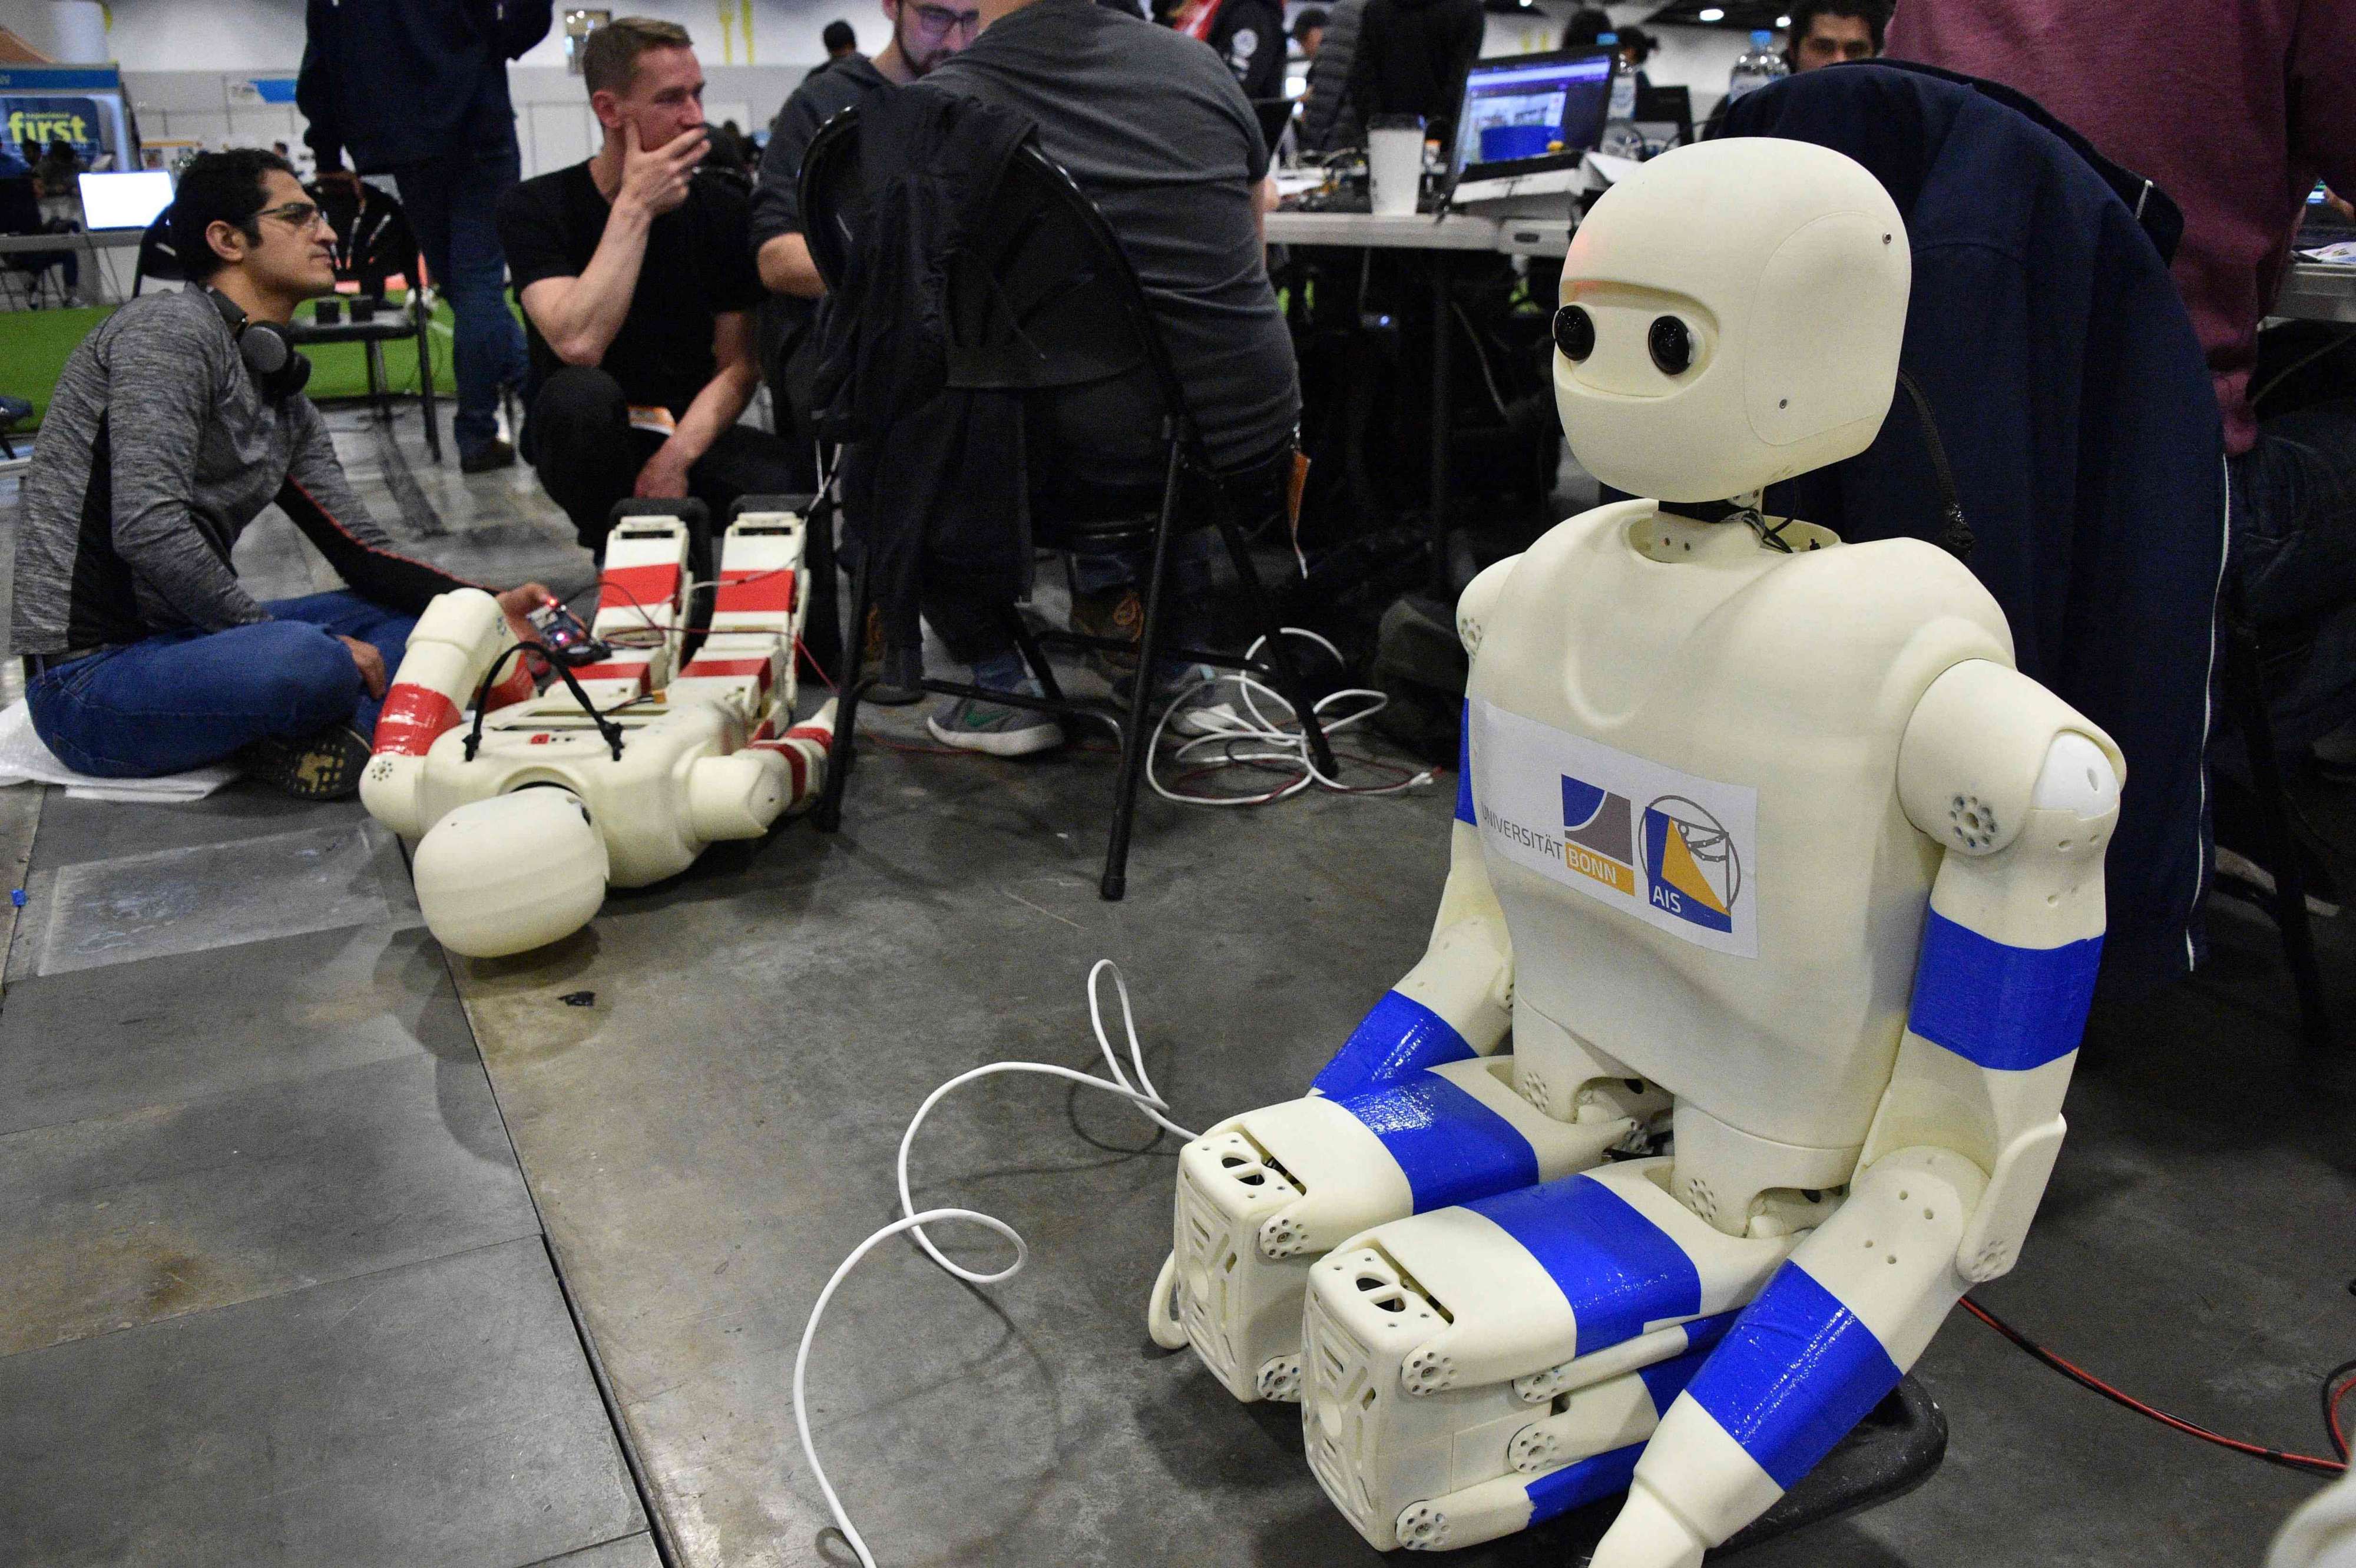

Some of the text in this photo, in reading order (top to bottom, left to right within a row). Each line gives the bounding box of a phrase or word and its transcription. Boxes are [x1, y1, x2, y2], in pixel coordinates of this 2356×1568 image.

[8, 111, 88, 143] first
[1481, 800, 1617, 884] UNIVERSITÄT BONN
[1652, 885, 1682, 913] AIS
